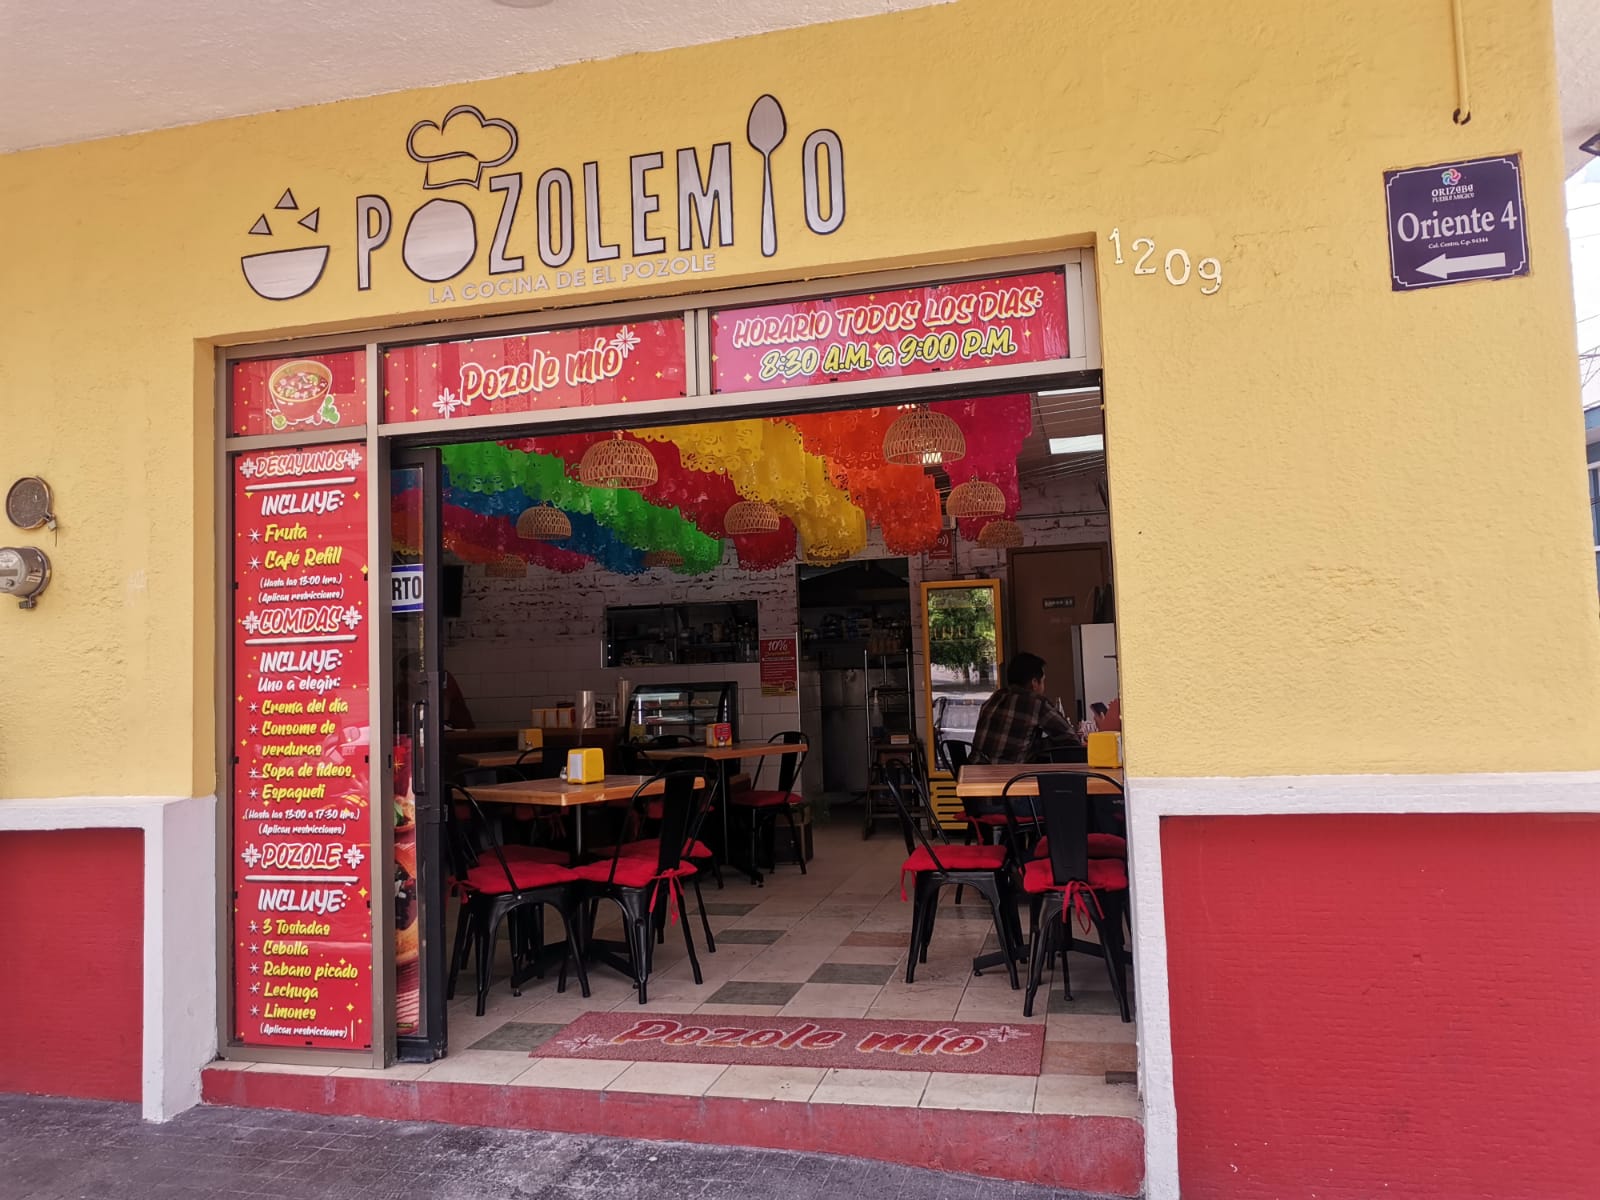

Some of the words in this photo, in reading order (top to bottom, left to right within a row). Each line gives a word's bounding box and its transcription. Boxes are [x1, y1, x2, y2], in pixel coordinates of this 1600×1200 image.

[1397, 207, 1496, 242] Oriente
[1500, 200, 1518, 230] 4
[1108, 227, 1222, 295] 1209
[428, 286, 455, 304] LA
[461, 275, 549, 300] COCINA
[555, 268, 586, 289] DE
[592, 265, 615, 285] EL
[620, 253, 716, 282] POZOLE
[733, 311, 832, 349] HORARIO
[838, 299, 920, 336] TODOS
[925, 293, 976, 328] LOS
[978, 287, 1044, 322] DIAS:
[759, 347, 819, 381] 8:30
[823, 343, 872, 373] A.M.
[877, 346, 895, 368] a
[898, 332, 957, 364] 9:00
[962, 327, 1017, 355] P.M.
[460, 349, 560, 406] Pozole
[565, 337, 623, 386] mío
[255, 450, 348, 477] DESAYUNOS
[261, 489, 345, 516] INCLUYE:
[264, 523, 307, 542] Fruta
[264, 549, 300, 570] Café
[303, 547, 342, 567] Refill
[286, 577, 297, 586] las
[258, 592, 289, 604] (Aplican
[258, 605, 343, 635] COMIDAS
[259, 649, 343, 674] INCLUYE:
[258, 677, 283, 692] Uno
[286, 680, 295, 691] a
[299, 675, 341, 695] elegir:
[262, 699, 303, 715] Crema
[307, 698, 326, 713] del
[262, 720, 317, 736] Consome
[320, 720, 336, 735] de
[262, 742, 322, 757] verduras
[262, 763, 294, 780] Sopa
[298, 762, 313, 778] de
[316, 761, 352, 778] fideos
[262, 784, 325, 803] Espagueti
[272, 809, 283, 819] las
[308, 811, 313, 819] a
[258, 823, 291, 835] (Aplican
[260, 843, 343, 869] POZOLE
[257, 888, 347, 915] INCLUYE:
[262, 918, 272, 935] 3
[276, 919, 330, 936] Tostadas
[263, 940, 309, 956] Cebolla
[263, 960, 311, 977] Rabano
[314, 963, 358, 981] picado
[264, 982, 319, 1003] Lechuga
[264, 1003, 316, 1020] Limones
[260, 1022, 291, 1036] (Aplican
[606, 1018, 846, 1051] Pozole
